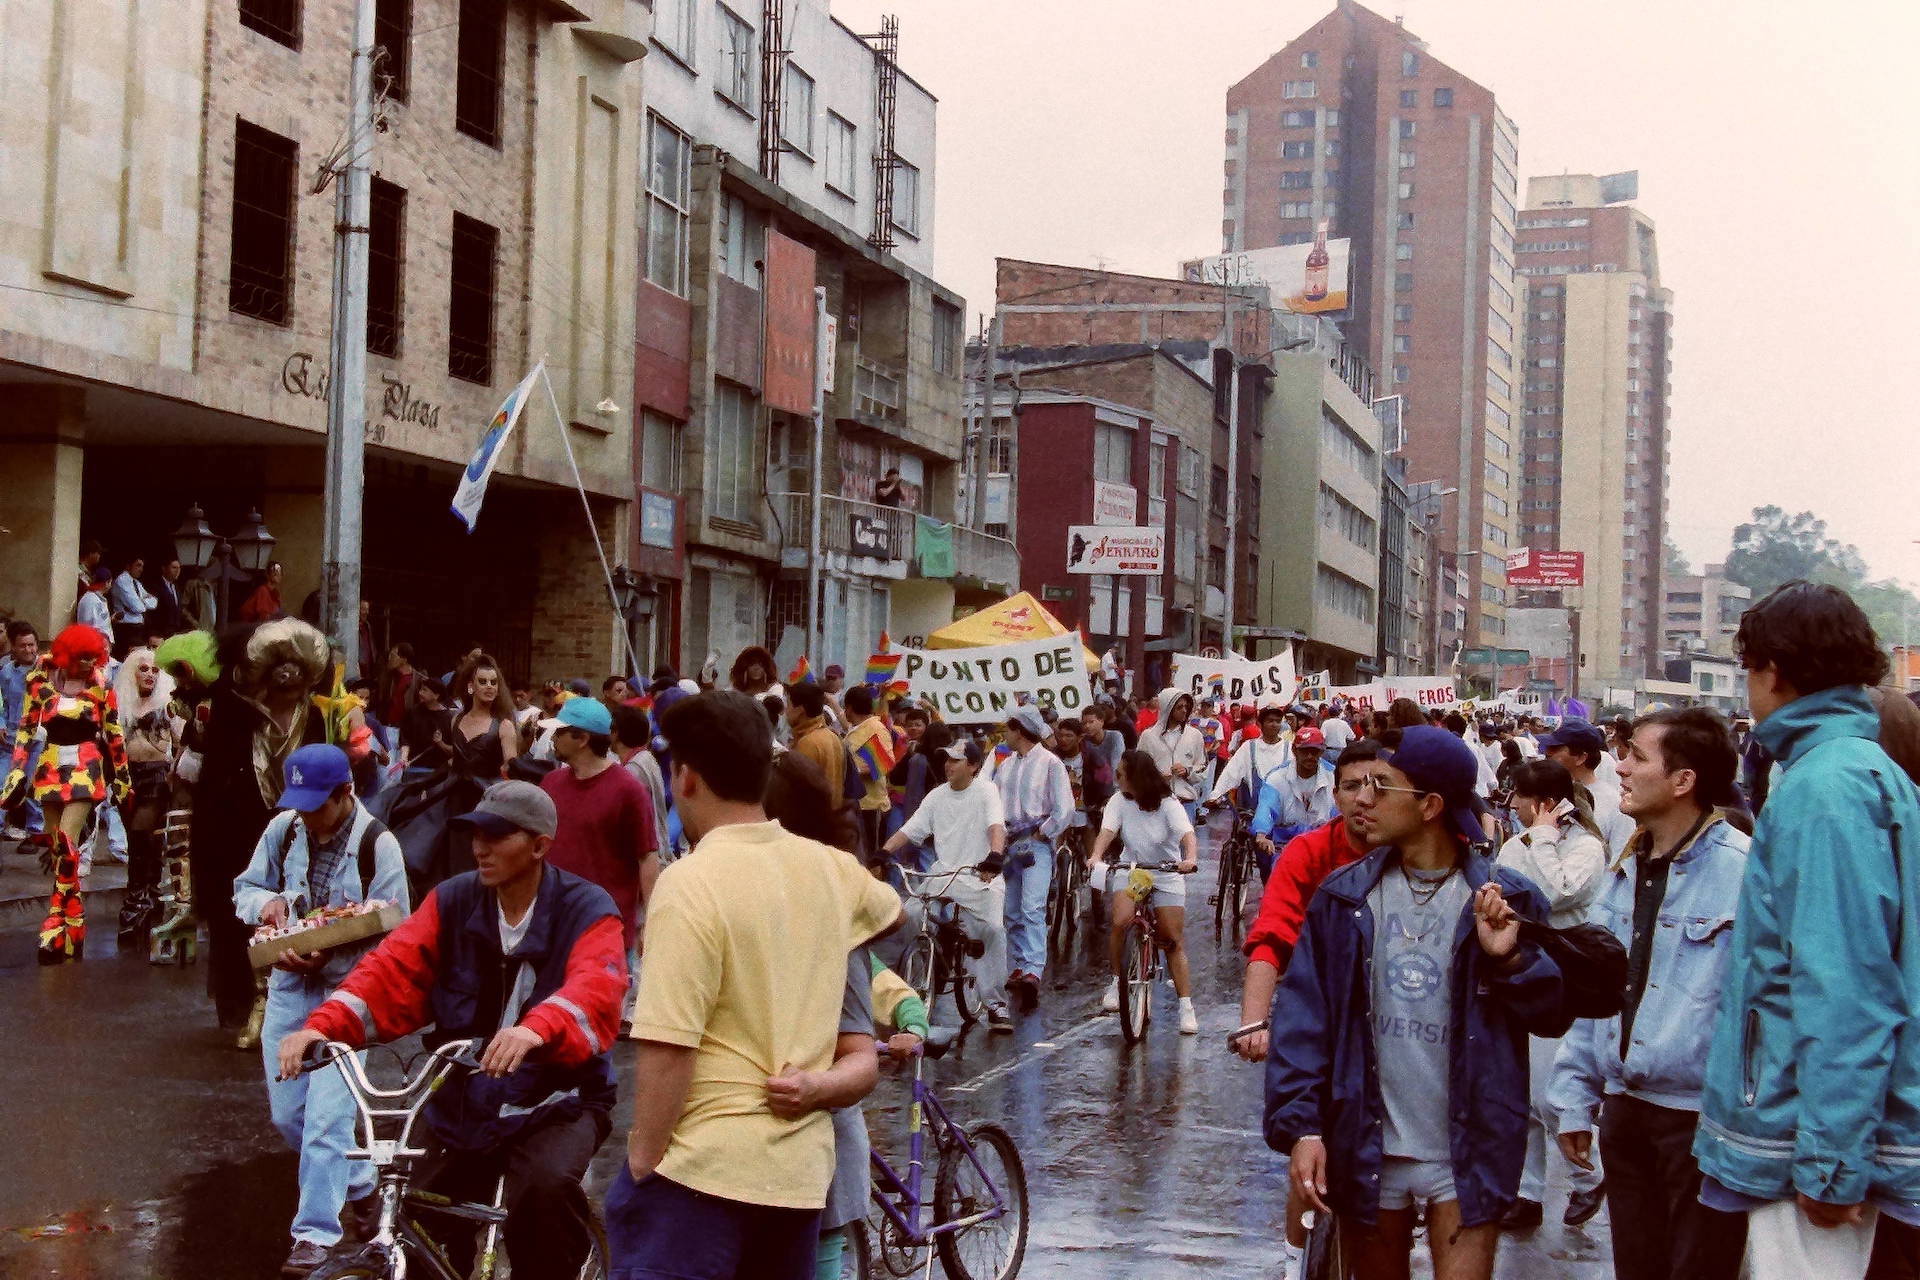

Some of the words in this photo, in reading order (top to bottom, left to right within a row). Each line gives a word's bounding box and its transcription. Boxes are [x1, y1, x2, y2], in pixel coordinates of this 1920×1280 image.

[382, 374, 440, 428] Plaza
[906, 653, 1020, 683] PUNTO
[1034, 647, 1074, 677] DE
[906, 684, 1081, 714] NCONRO
[1379, 1014, 1449, 1046] VERSI
